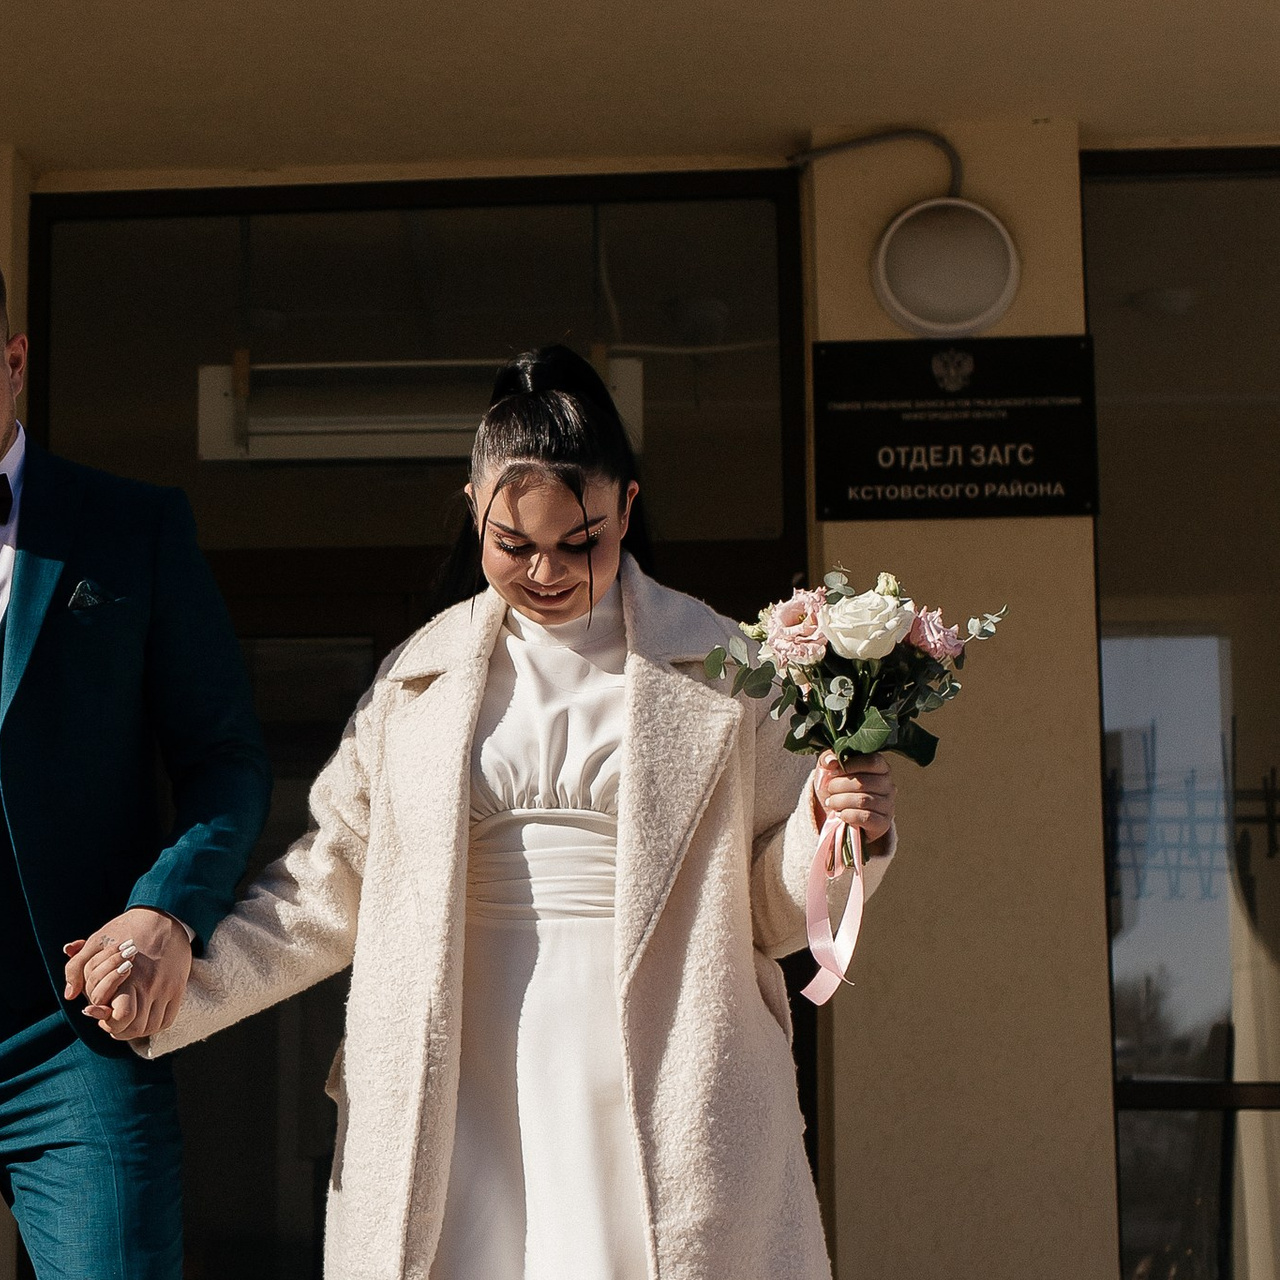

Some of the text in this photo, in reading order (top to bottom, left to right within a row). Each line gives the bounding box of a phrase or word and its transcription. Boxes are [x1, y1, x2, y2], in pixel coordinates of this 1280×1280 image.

[877, 443, 1035, 471] ОТДЕЛ ЗАГС
[848, 480, 1065, 501] КСТОВСКОГО РАЙОНА
